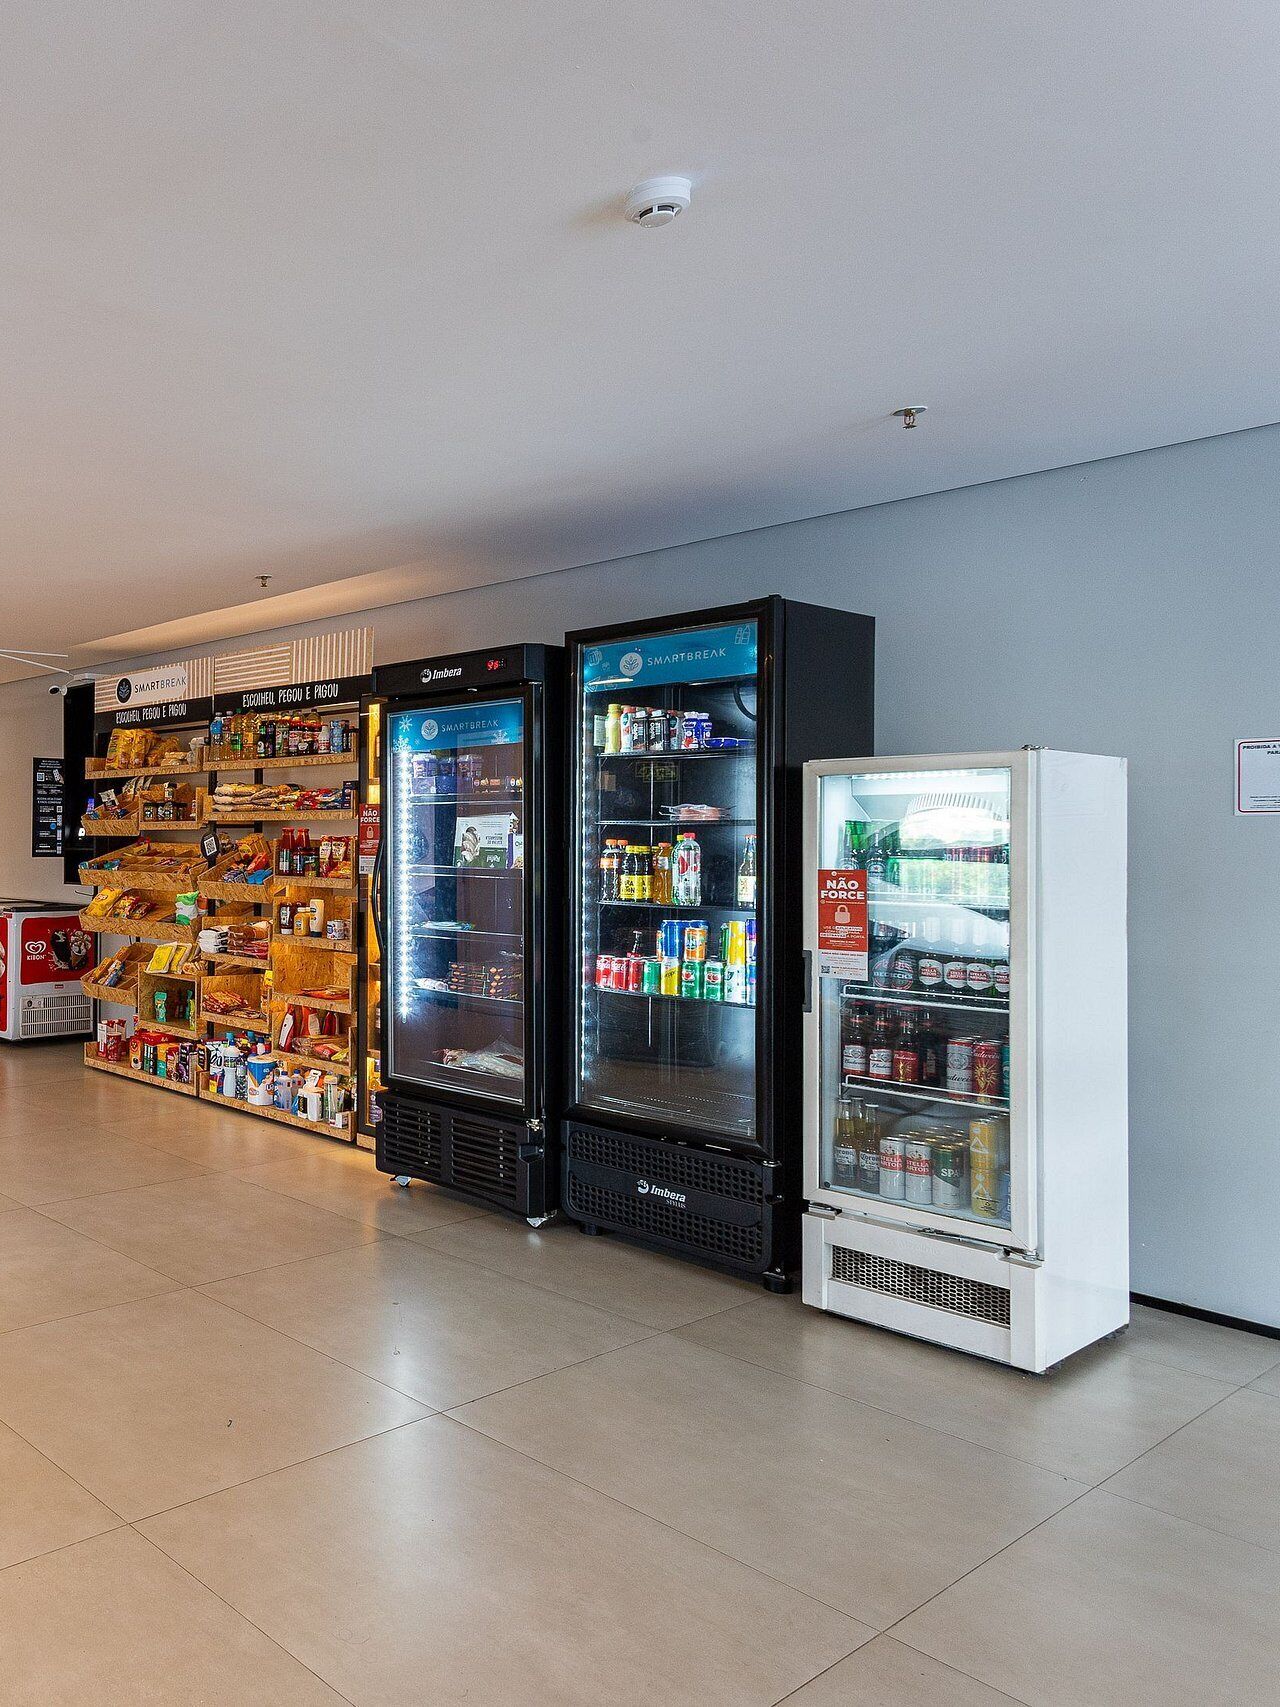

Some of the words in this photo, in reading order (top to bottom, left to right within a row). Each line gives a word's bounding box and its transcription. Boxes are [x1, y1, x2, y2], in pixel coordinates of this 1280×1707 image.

[647, 647, 727, 666] SMARTBREAK
[432, 667, 462, 680] Imbera
[134, 676, 187, 694] SMARTBREAK
[242, 691, 276, 708] ESCOLHEU,
[278, 687, 303, 703] PEGOU
[305, 686, 311, 700] E
[314, 683, 339, 699] PAGOU
[142, 706, 160, 721] PEGOU
[162, 705, 166, 718] E
[168, 703, 187, 717] PAGOU
[441, 719, 499, 732] SMARTBREAK
[362, 808, 378, 817] NÃO
[826, 877, 859, 890] NÃO
[820, 890, 865, 900] FORCE
[906, 1160, 929, 1168] STELLA
[650, 1184, 686, 1202] Imbera
